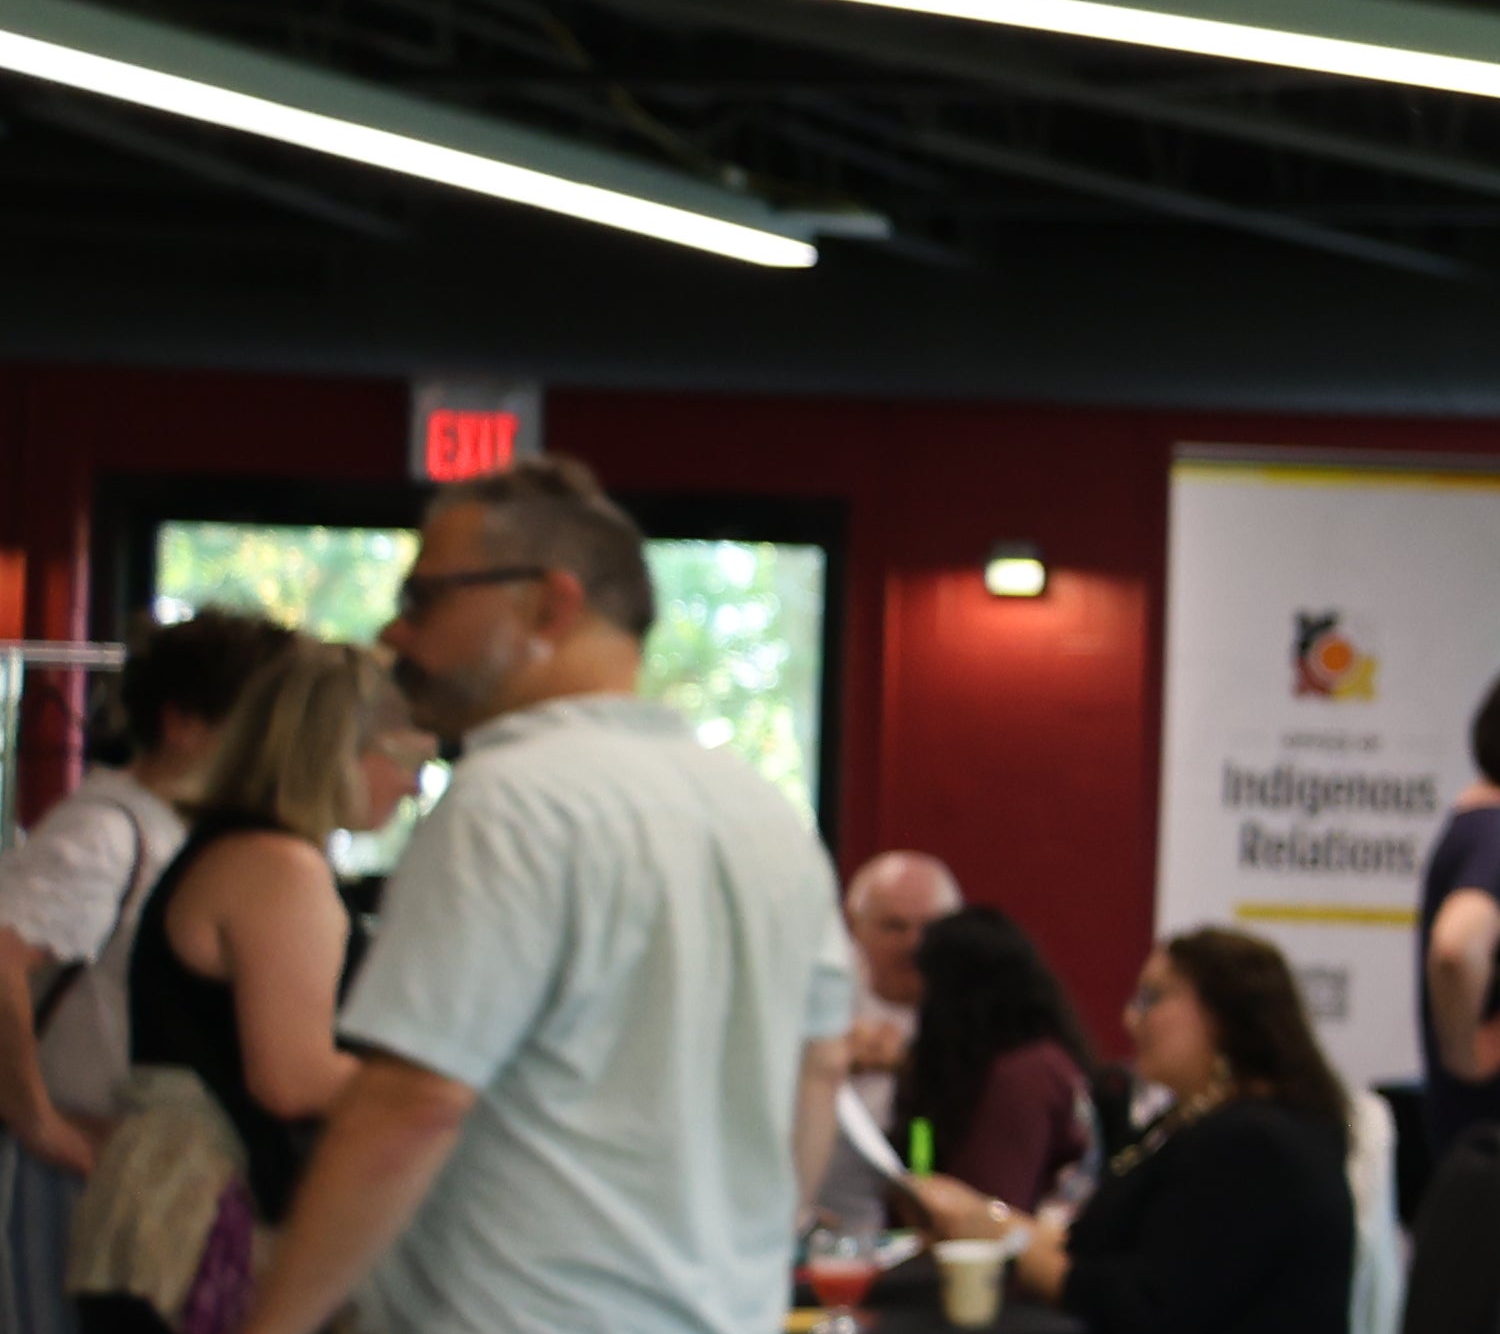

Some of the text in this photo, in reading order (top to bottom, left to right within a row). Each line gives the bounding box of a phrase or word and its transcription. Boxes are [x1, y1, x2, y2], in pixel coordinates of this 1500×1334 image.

[427, 410, 518, 481] EXIT
[1223, 761, 1437, 816] Indigenous
[1239, 821, 1418, 871] Relations
